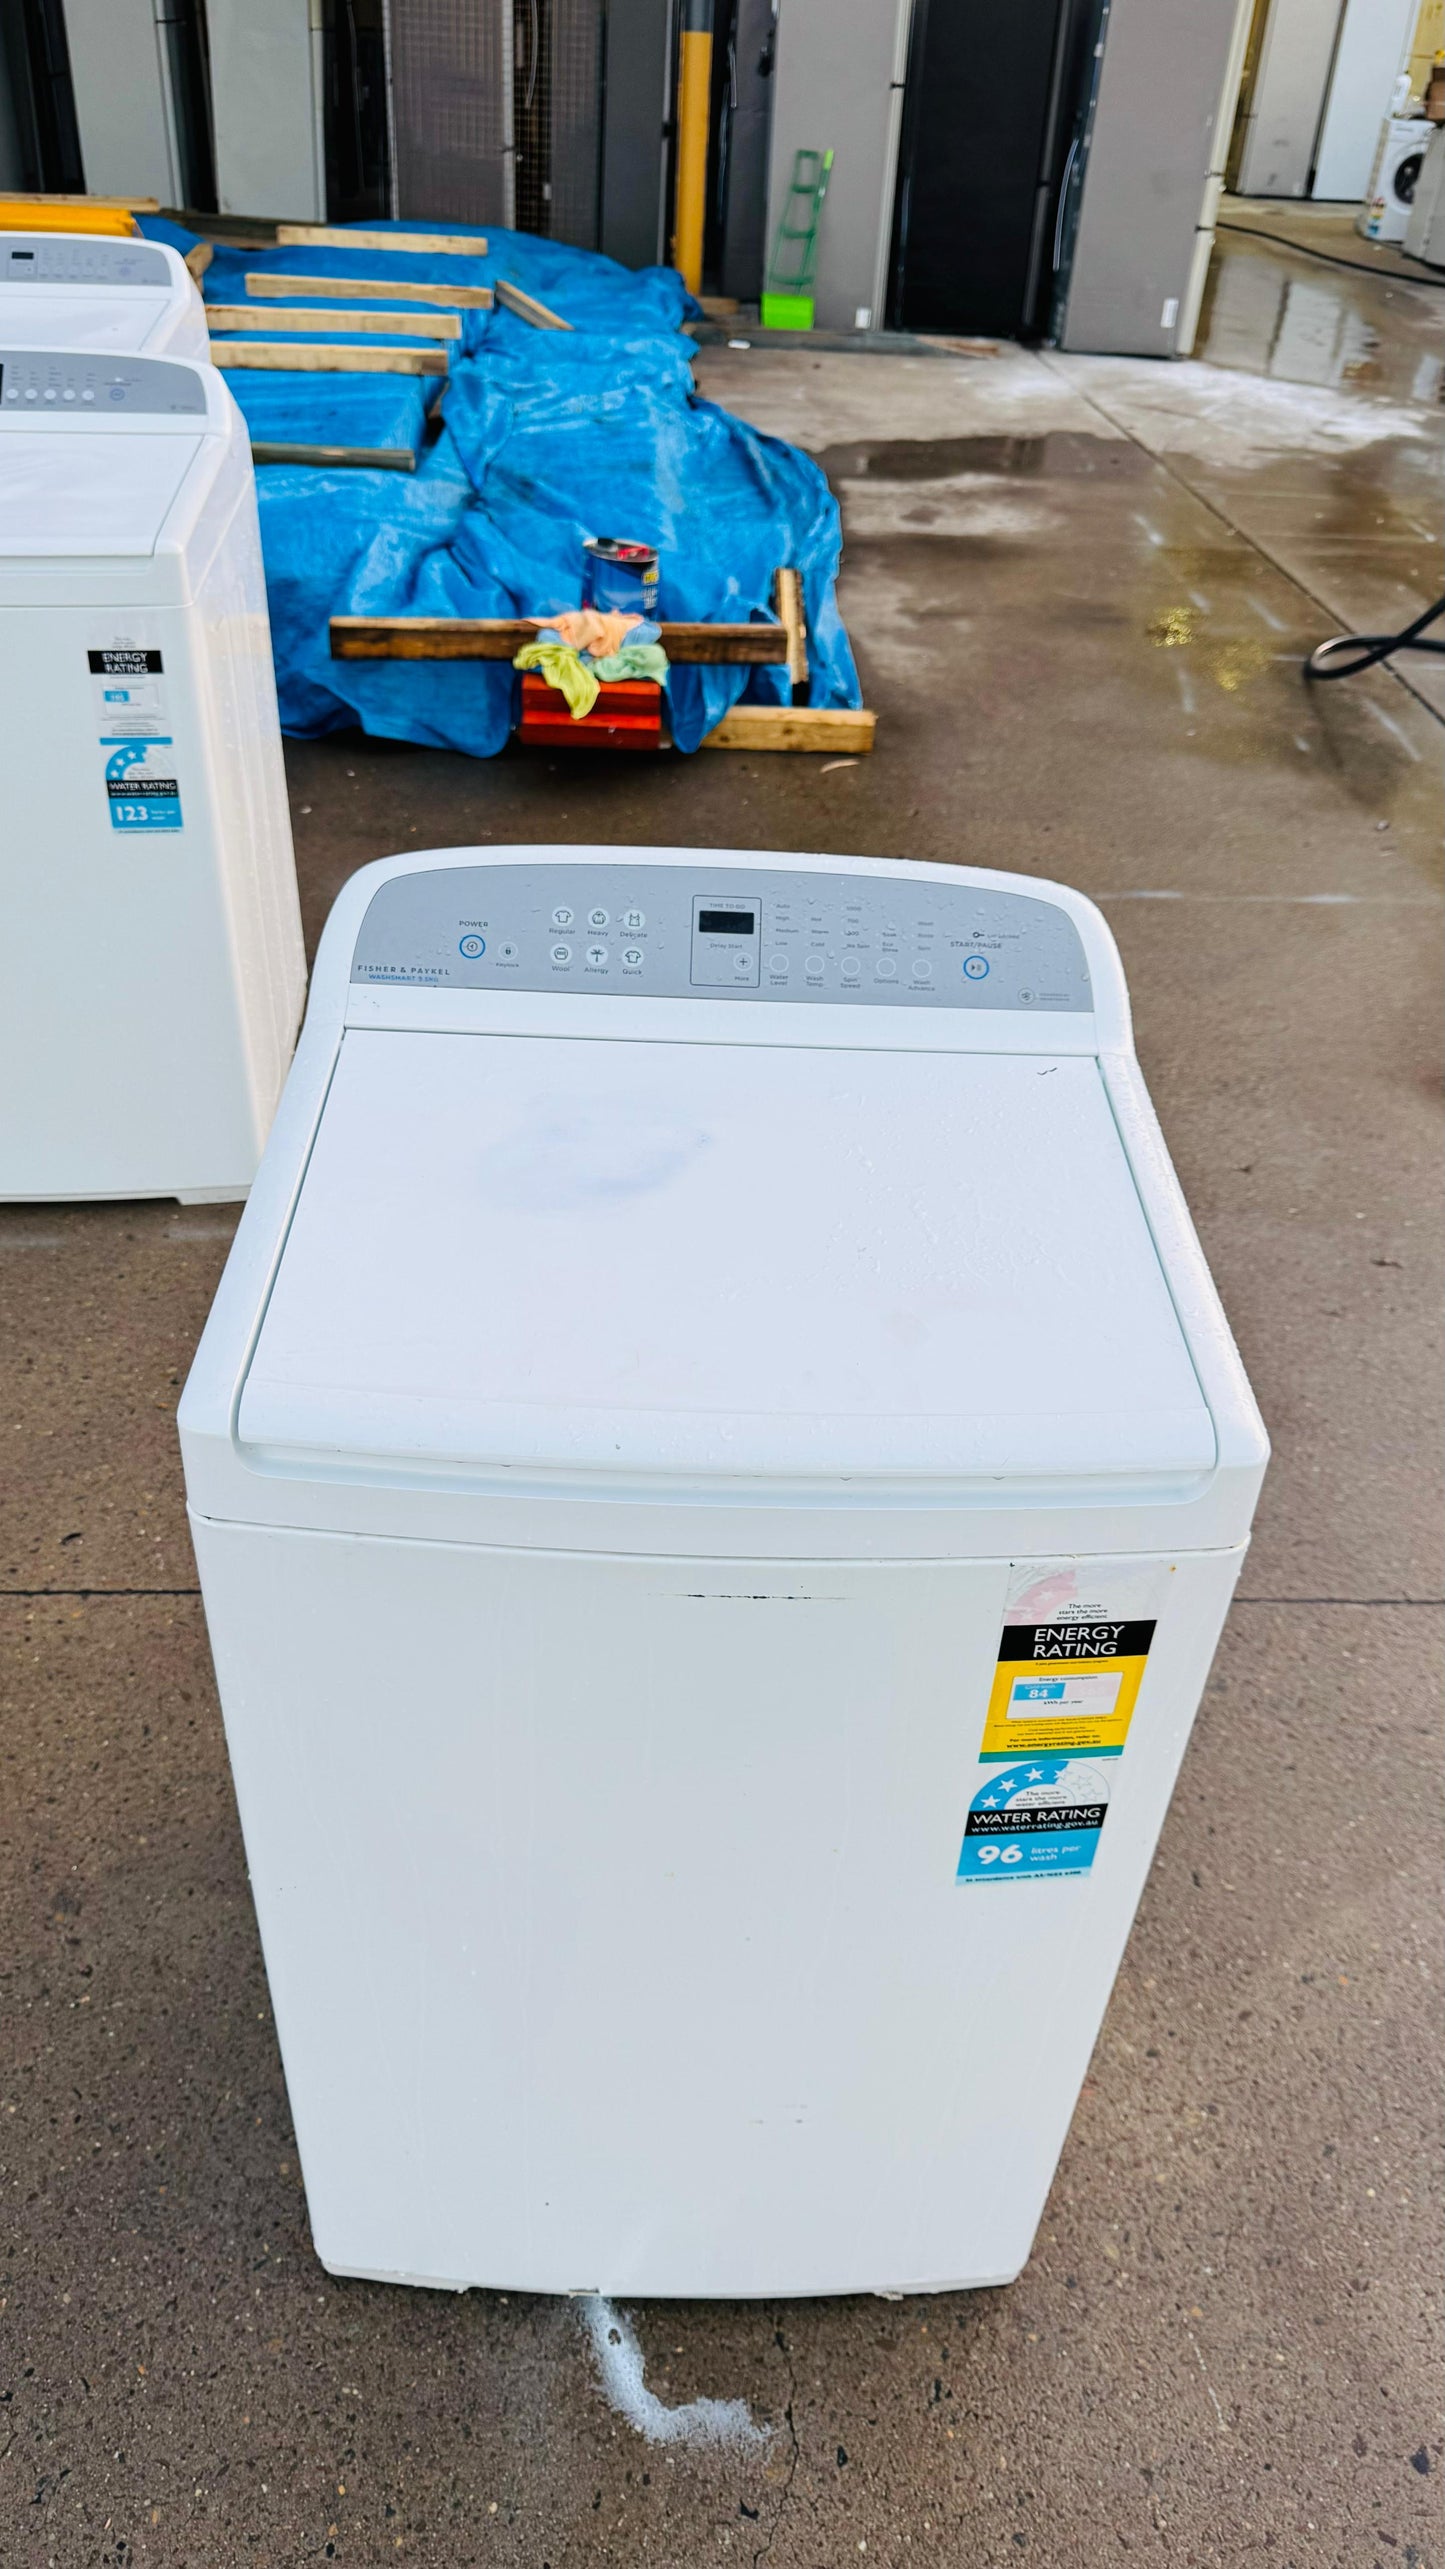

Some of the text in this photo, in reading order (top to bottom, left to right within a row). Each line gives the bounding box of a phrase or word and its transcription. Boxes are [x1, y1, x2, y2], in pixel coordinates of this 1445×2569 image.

[102, 652, 147, 663] ENERGY
[104, 663, 148, 673] RATING
[116, 806, 149, 821] 123
[459, 920, 489, 928] POWER
[950, 941, 1002, 949] START/PAUSE
[357, 964, 397, 973] FISHER
[411, 967, 451, 976] PAYKEL
[584, 967, 609, 975] Allergy
[1034, 1625, 1125, 1642] ENERGY
[1033, 1641, 1118, 1658] RATING
[1028, 1689, 1049, 1698] 84
[973, 1807, 1101, 1825] WATER RATING
[971, 1819, 1099, 1833] www.waterrating.gov.au
[977, 1844, 1024, 1865] 96
[1061, 1845, 1082, 1854] per
[1030, 1854, 1058, 1862] wash
